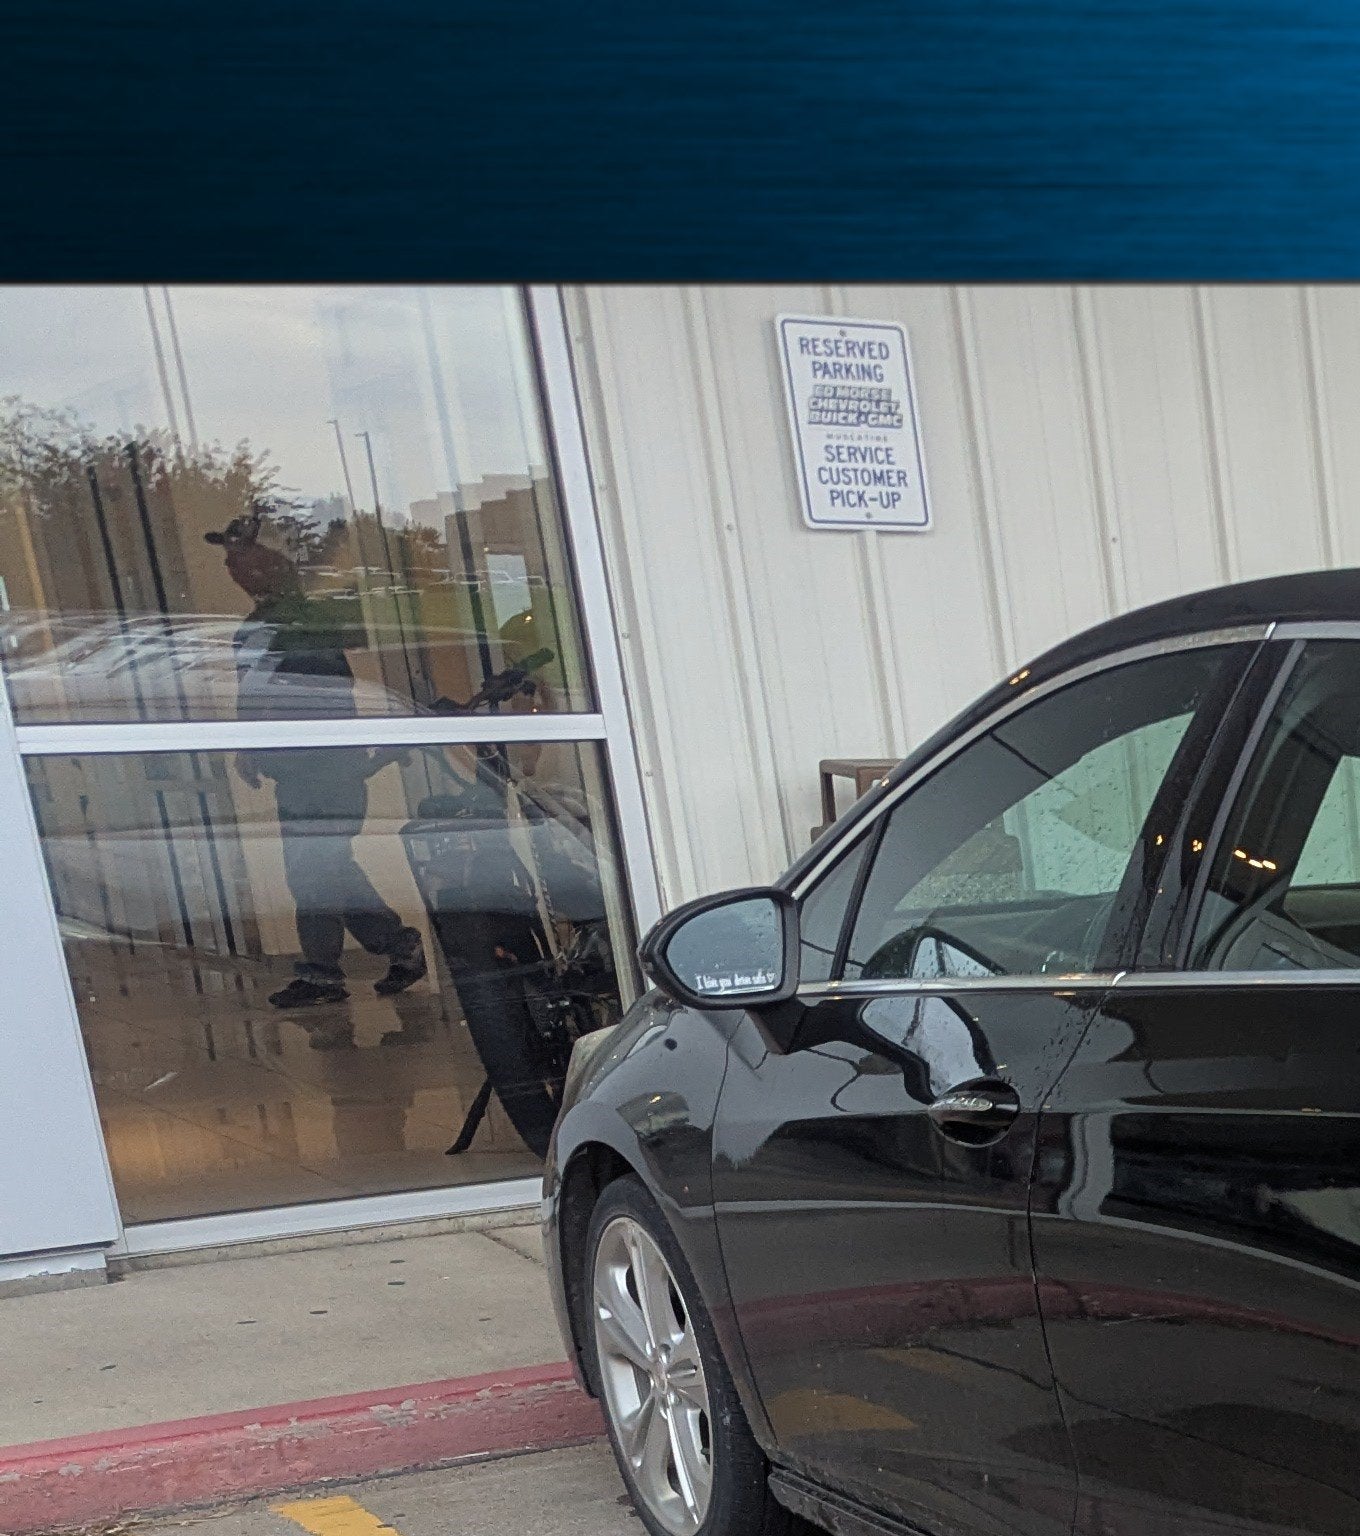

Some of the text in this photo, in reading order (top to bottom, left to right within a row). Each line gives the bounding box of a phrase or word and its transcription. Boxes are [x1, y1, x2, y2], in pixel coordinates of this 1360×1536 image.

[799, 336, 890, 360] RESERVED
[812, 361, 884, 382] PARKING
[808, 398, 900, 414] CHEVROLET
[823, 445, 896, 465] SERVICE
[818, 467, 908, 487] CUSTOMER
[829, 490, 901, 509] PICK-UP
